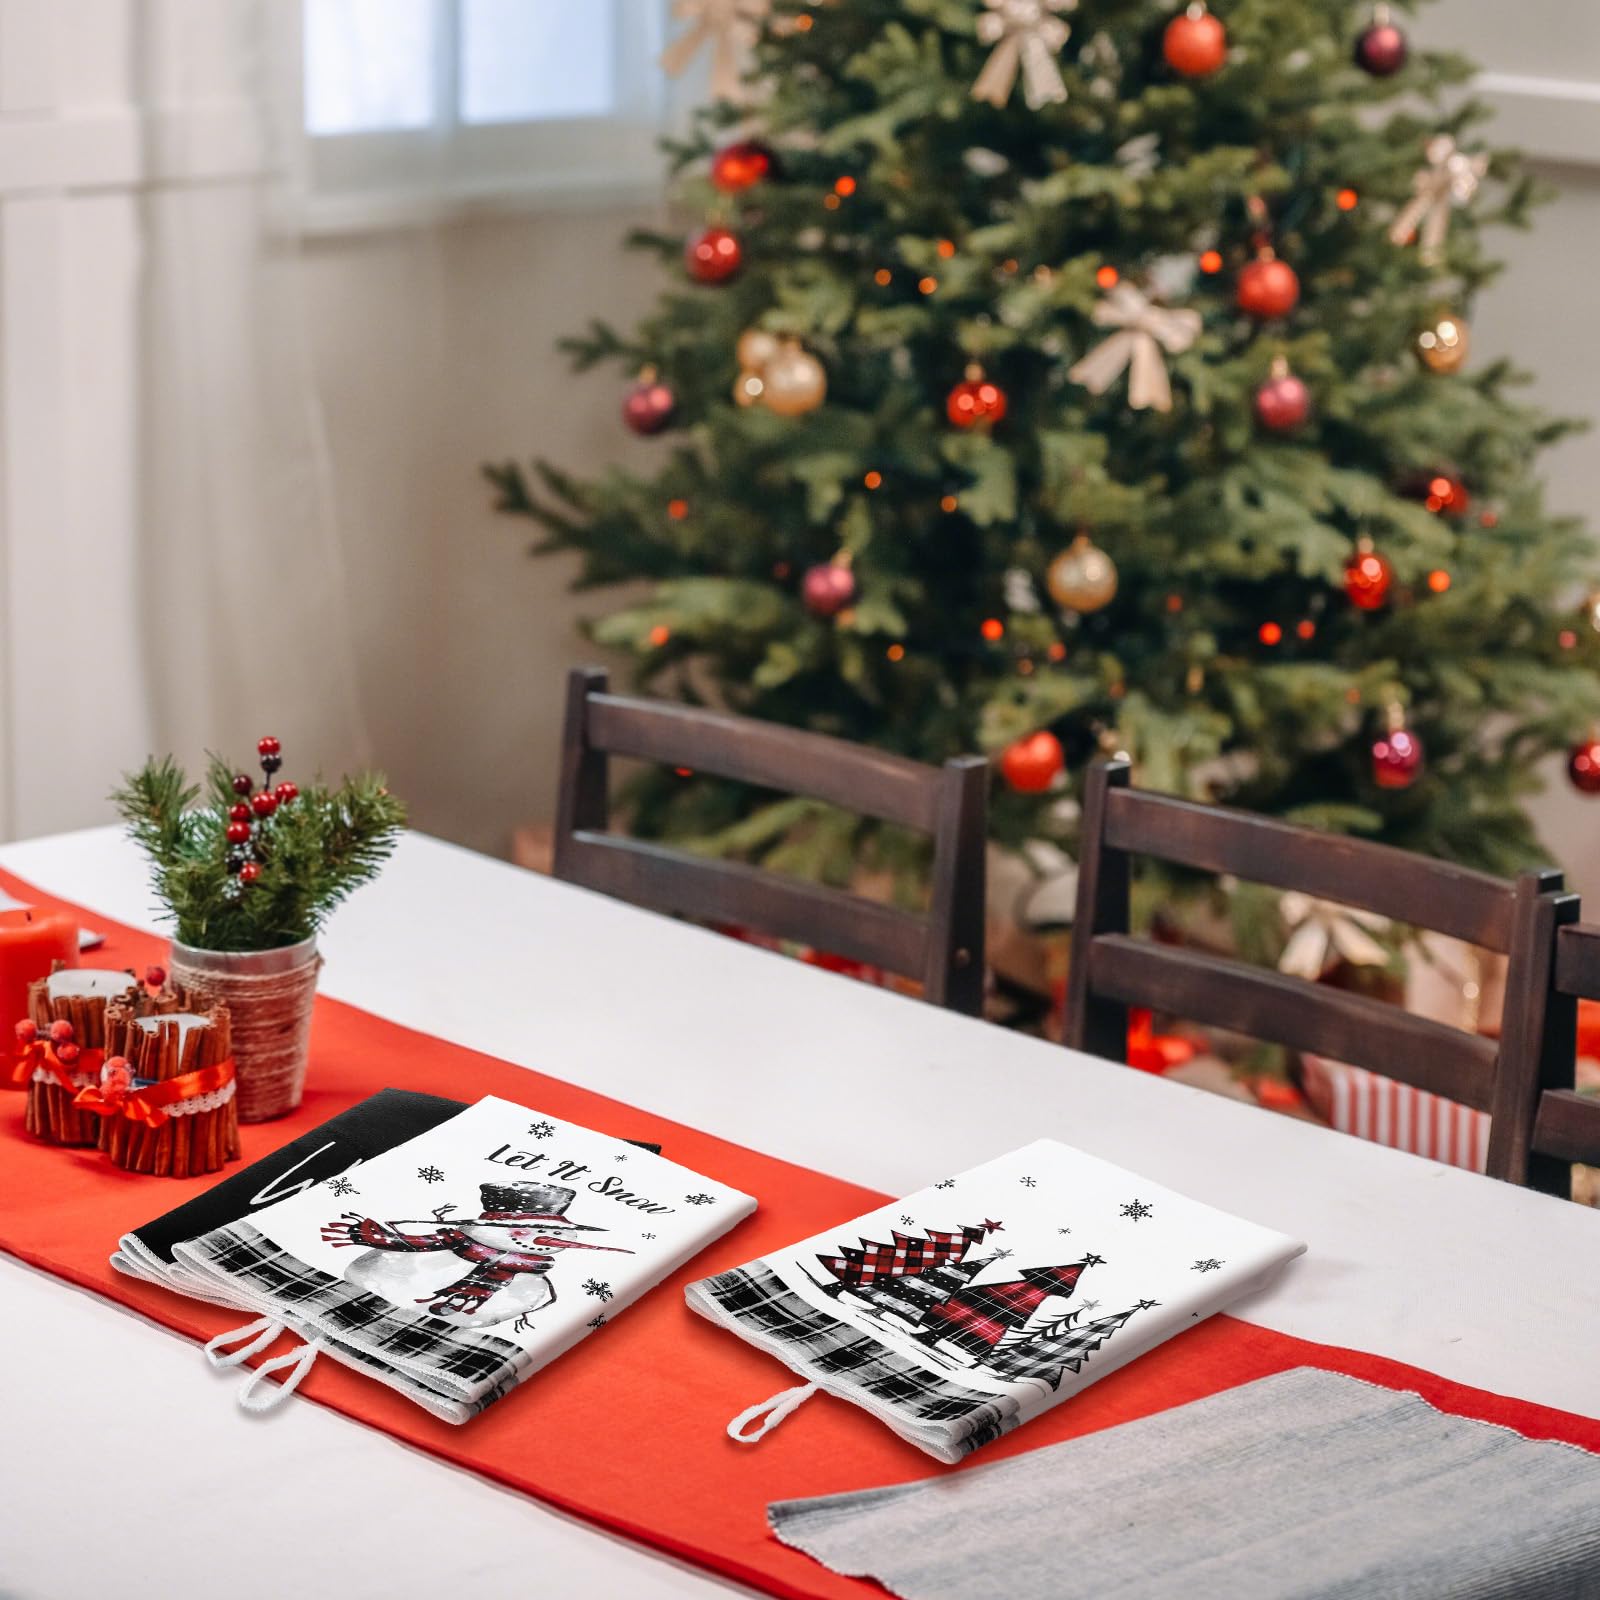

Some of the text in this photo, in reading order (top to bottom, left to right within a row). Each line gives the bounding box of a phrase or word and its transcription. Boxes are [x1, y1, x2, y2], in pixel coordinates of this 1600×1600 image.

[484, 1143, 676, 1215] Let It Snow
